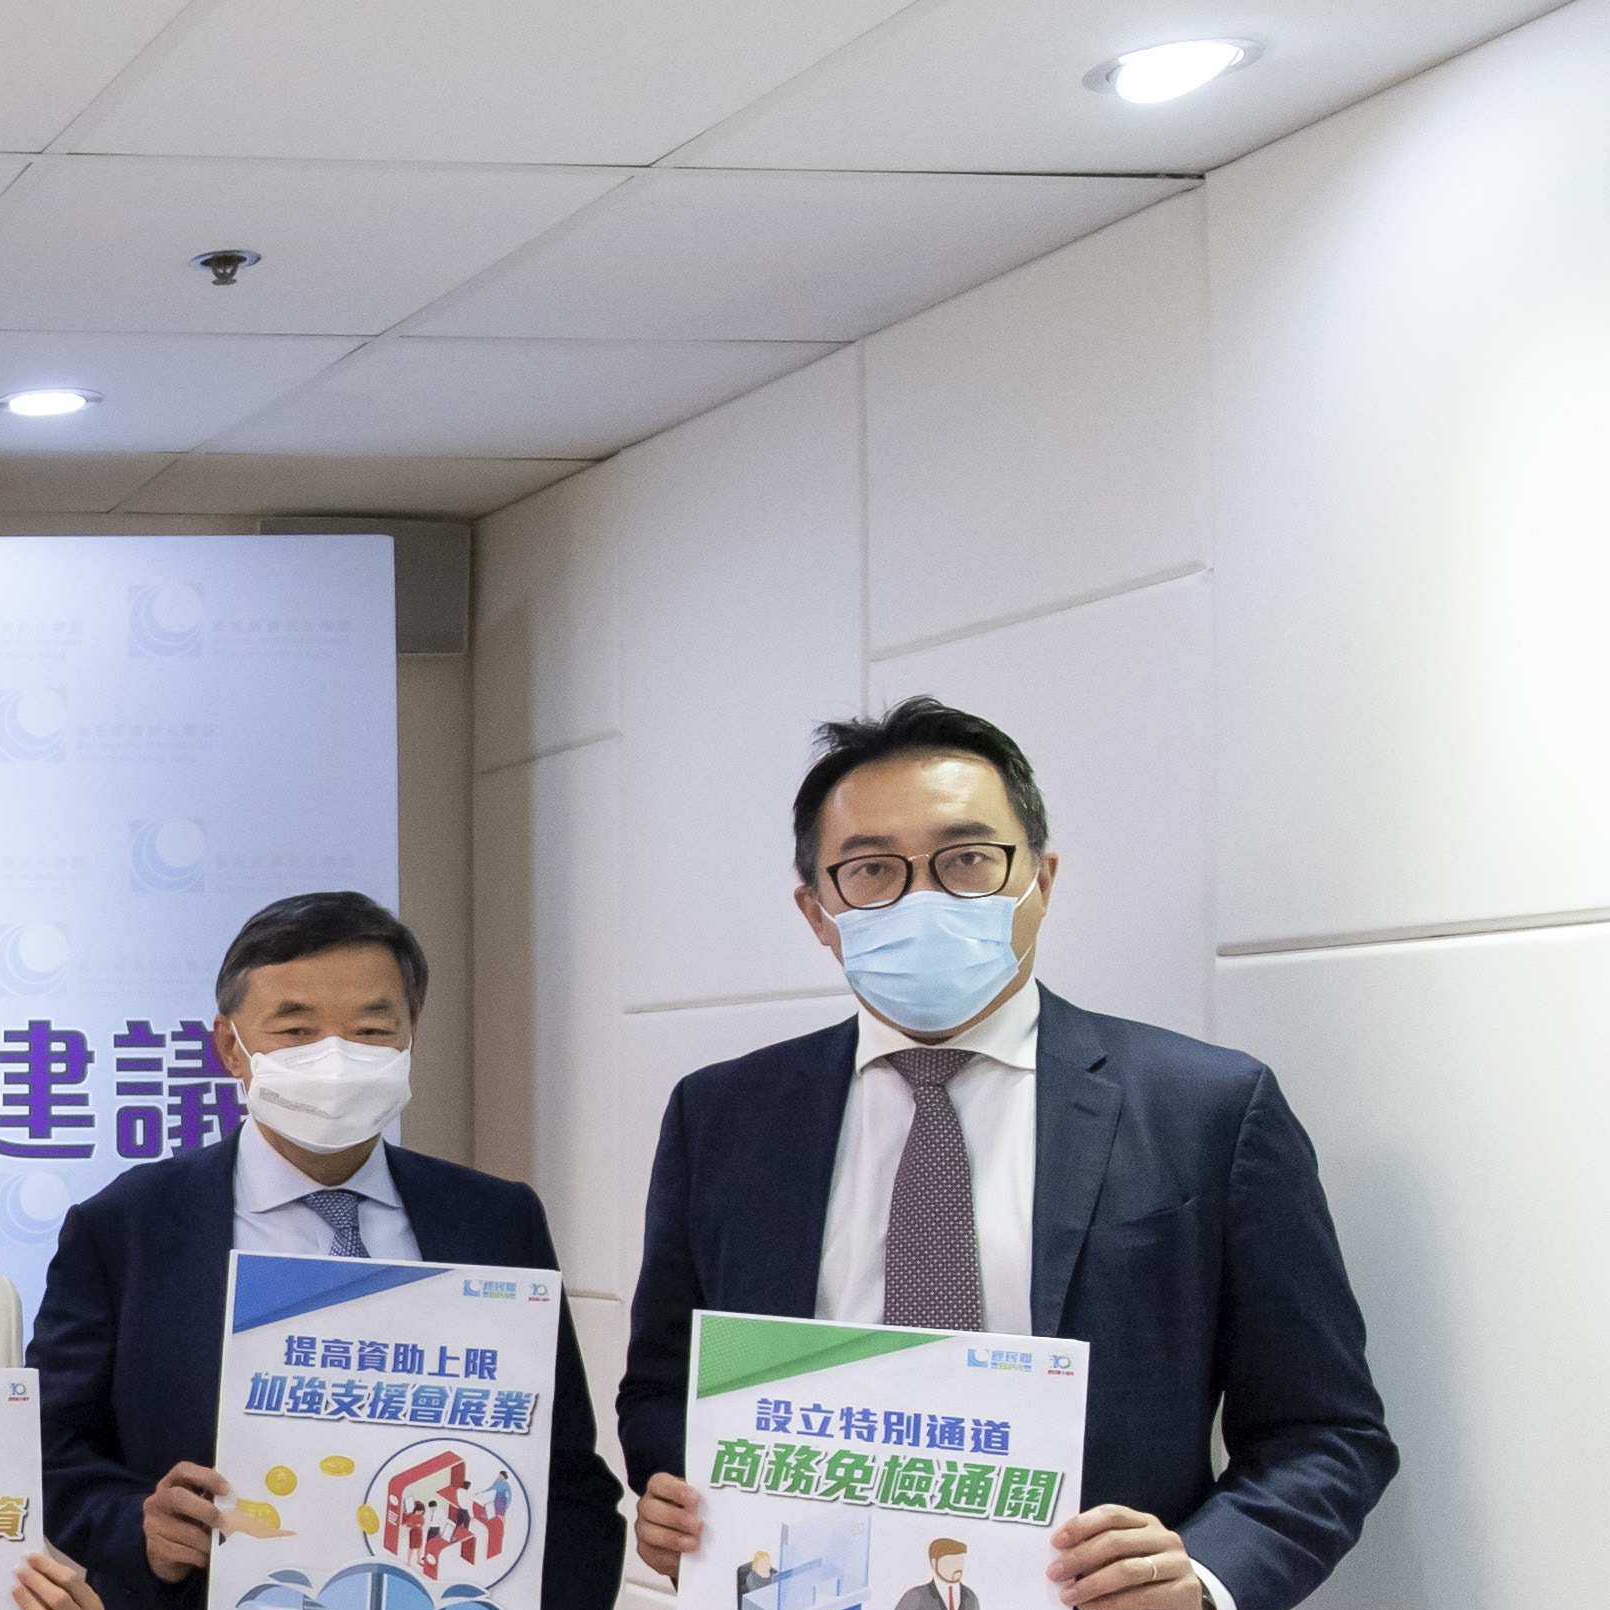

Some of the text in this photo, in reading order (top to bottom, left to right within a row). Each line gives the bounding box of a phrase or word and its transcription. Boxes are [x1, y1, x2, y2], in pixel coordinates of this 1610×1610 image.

[284, 1335, 499, 1381] 提高資助上限
[245, 1371, 535, 1431] 加強支援會展業
[755, 1397, 1011, 1456] 設立特別通道
[709, 1438, 1063, 1523] 商務免檢通關
